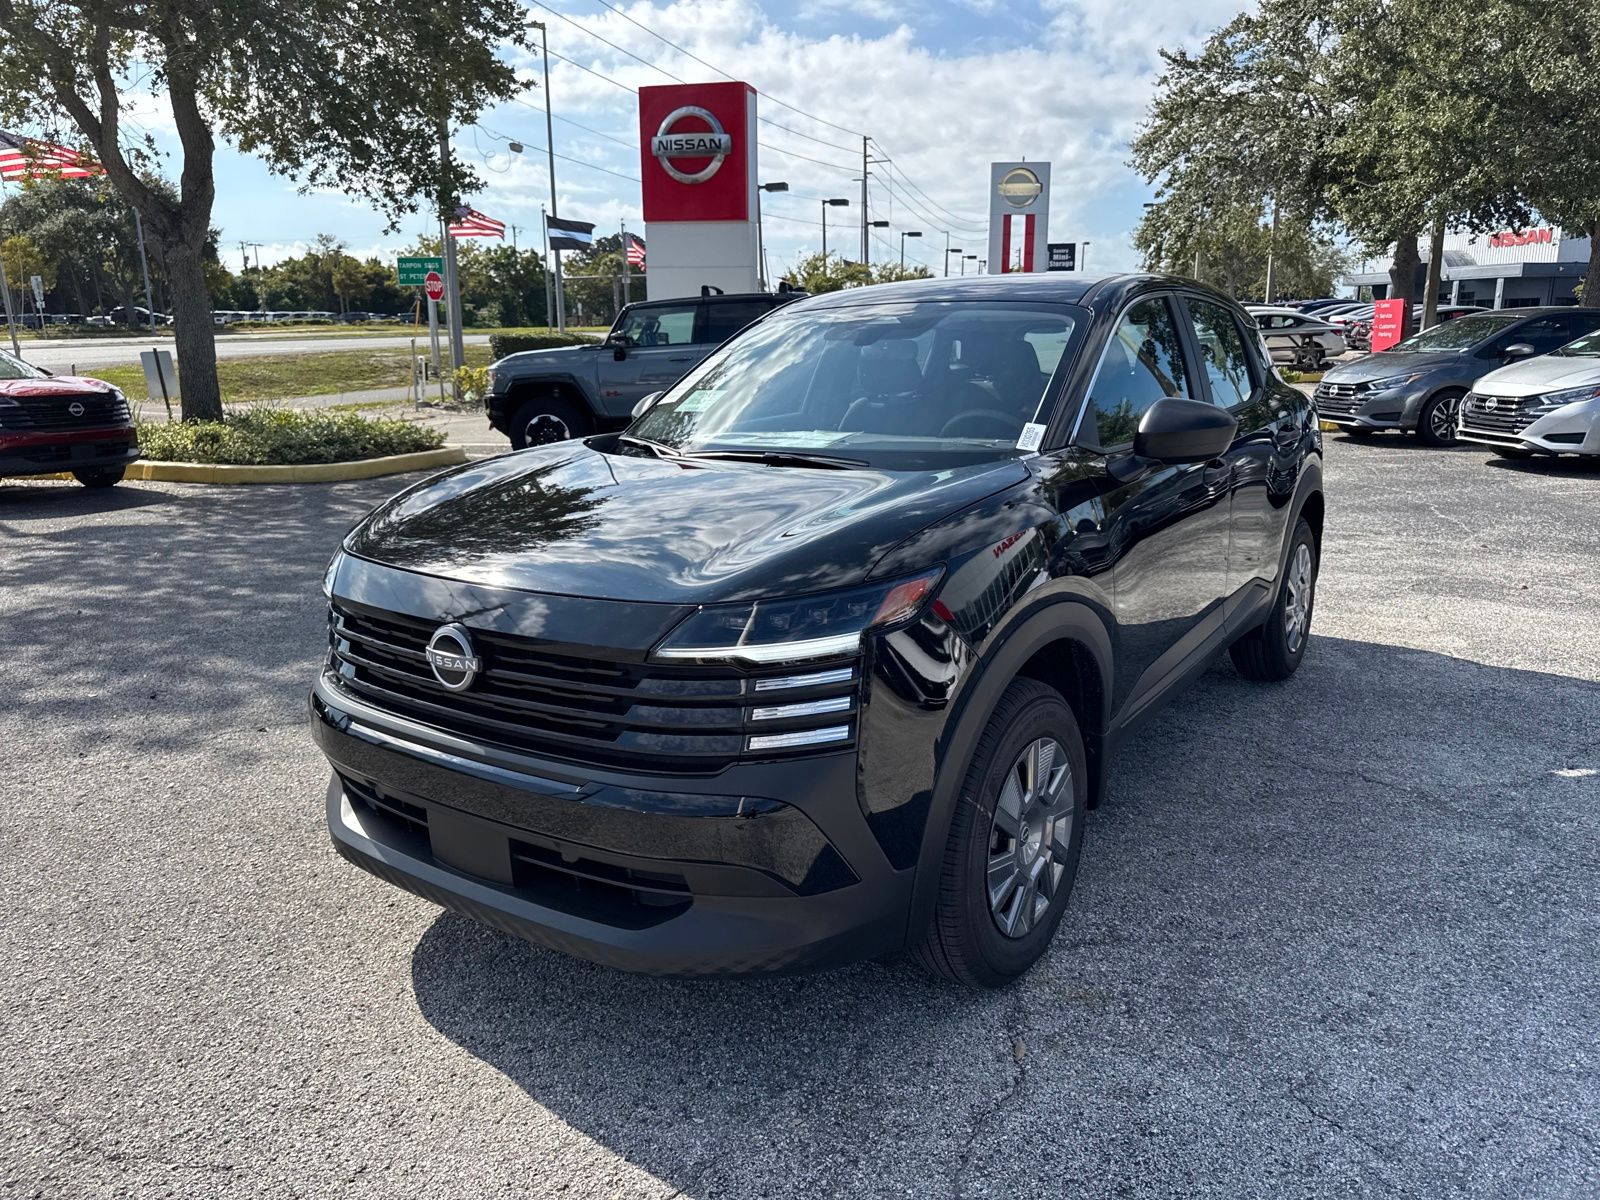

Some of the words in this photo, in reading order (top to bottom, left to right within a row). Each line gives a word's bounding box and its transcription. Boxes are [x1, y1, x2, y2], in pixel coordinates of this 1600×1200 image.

[658, 138, 722, 151] NISSAN
[1489, 229, 1552, 248] NISSAN
[426, 281, 442, 292] STOP
[425, 650, 476, 670] NISSAN
